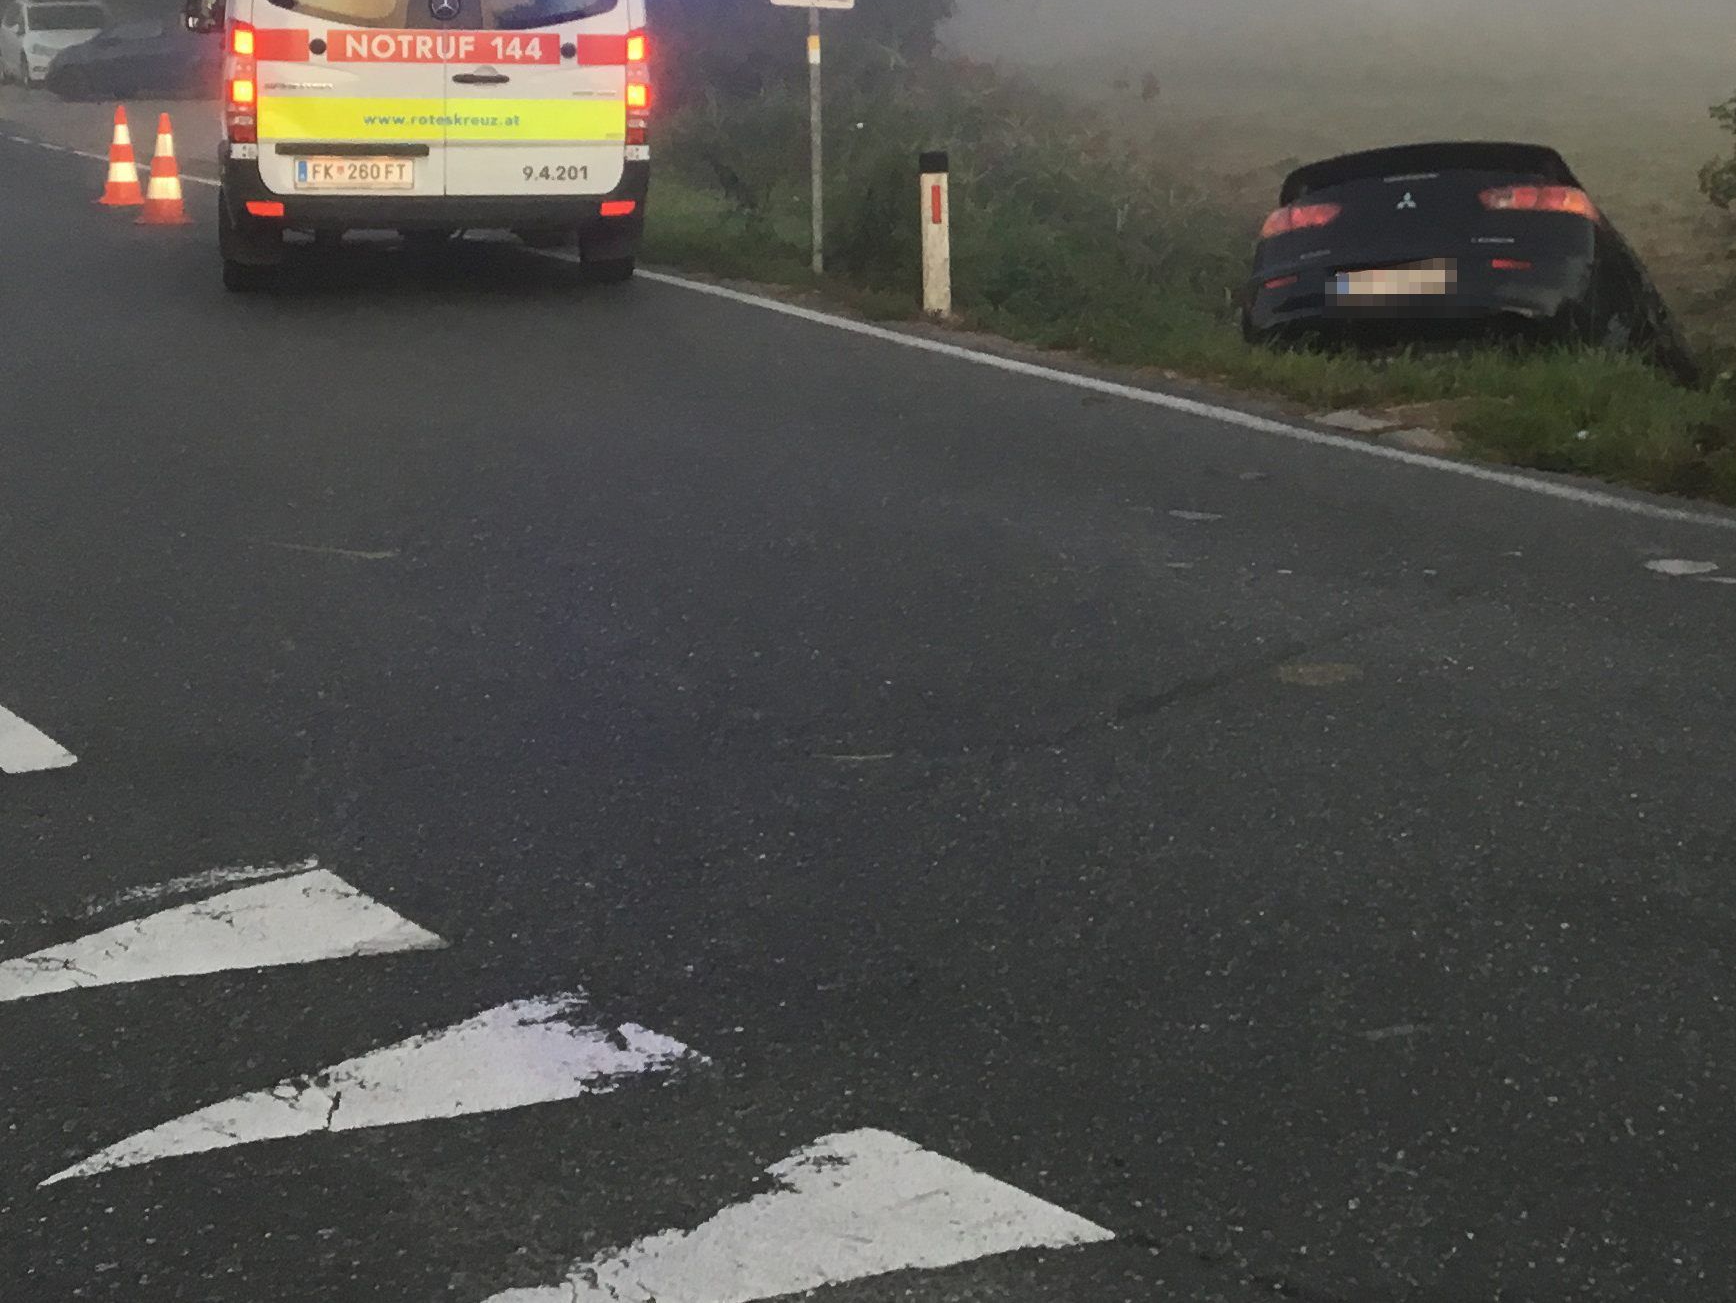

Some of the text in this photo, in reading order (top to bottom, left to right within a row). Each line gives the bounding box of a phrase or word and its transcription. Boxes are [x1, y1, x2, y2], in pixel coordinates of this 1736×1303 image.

[345, 34, 543, 60] NOTRUF 144
[311, 163, 334, 180] FK
[522, 165, 589, 181] 9.4.201
